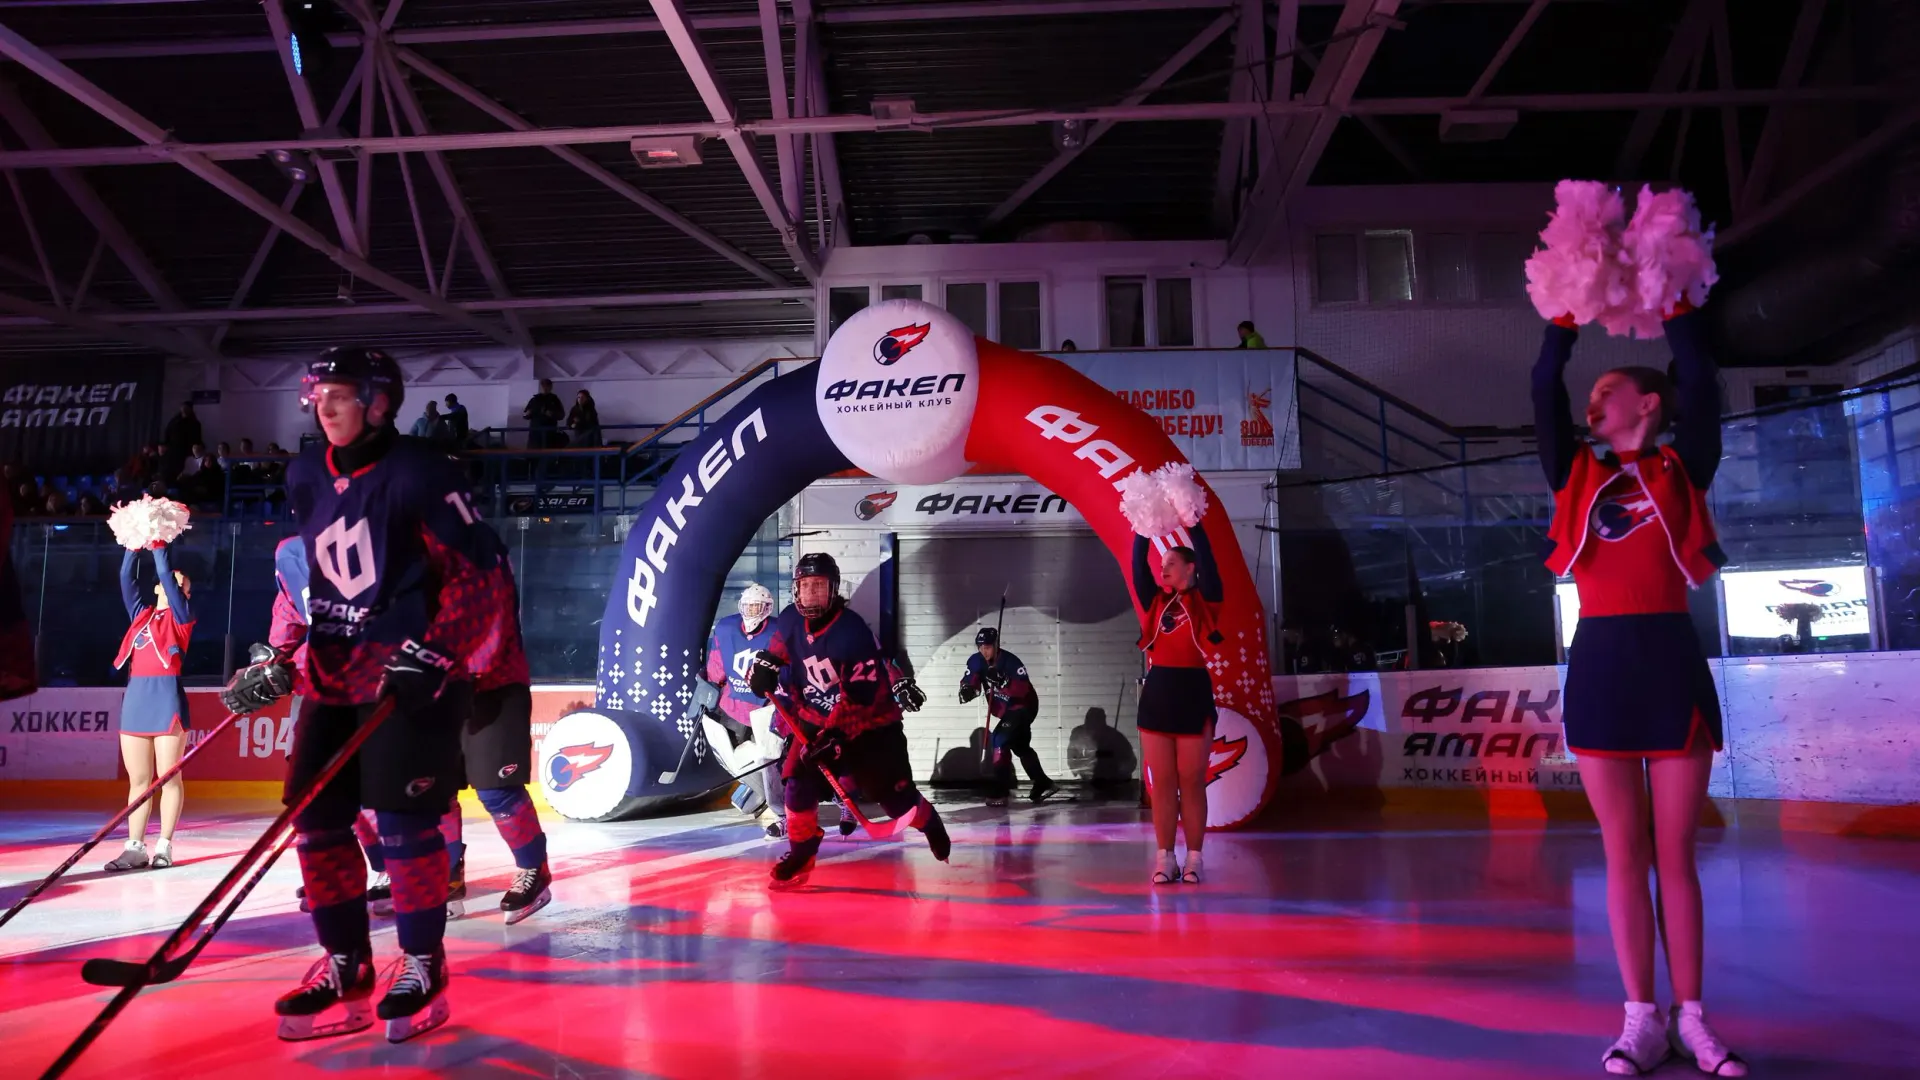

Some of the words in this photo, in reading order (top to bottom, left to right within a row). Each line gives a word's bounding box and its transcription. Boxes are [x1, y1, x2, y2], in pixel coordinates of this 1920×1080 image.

[2, 382, 138, 404] ФАКЕЛ
[824, 374, 966, 401] ФАКЕЛ
[837, 399, 913, 413] ХОККЕЙНЫЙ
[919, 398, 952, 408] КЛУБ
[1117, 390, 1195, 410] ПАСИБО
[1, 407, 110, 428] ЯМАЛ
[915, 493, 1067, 515] ФАКЕЛ
[627, 407, 768, 628] ФАКЕЛ
[401, 639, 454, 669] CCM
[891, 679, 908, 693] CM
[1401, 685, 1564, 724] ФАК
[10, 711, 109, 733] ХОККЕЯ
[234, 716, 294, 758] 194
[1403, 732, 1560, 759] ЯМАЛ
[1404, 766, 1539, 785] ХОККЕЙНЫЙ
[1552, 770, 1582, 786] КЛ
